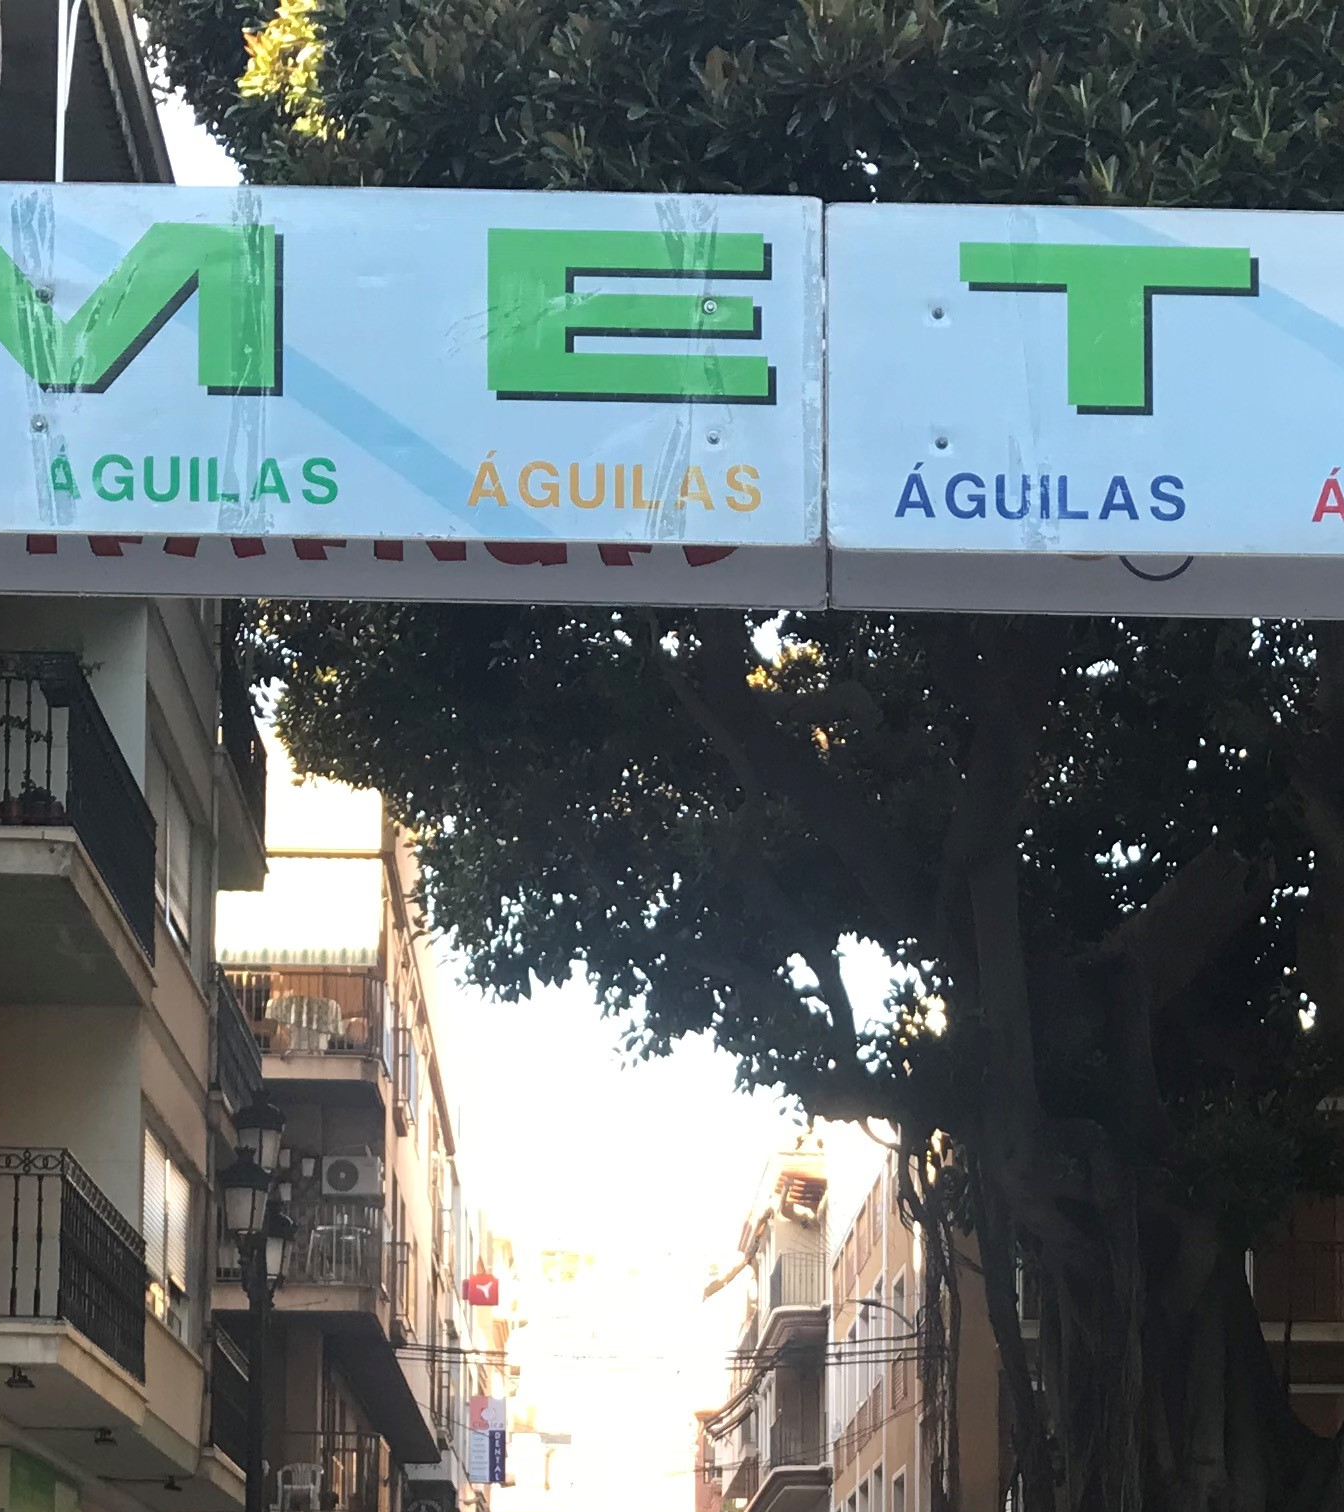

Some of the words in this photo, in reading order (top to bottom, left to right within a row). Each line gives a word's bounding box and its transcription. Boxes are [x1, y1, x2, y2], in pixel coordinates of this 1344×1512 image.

[48, 446, 339, 506] ÁGUILAS
[466, 451, 763, 514] ÁGUILAS
[895, 463, 1187, 522] ÁGUILAS
